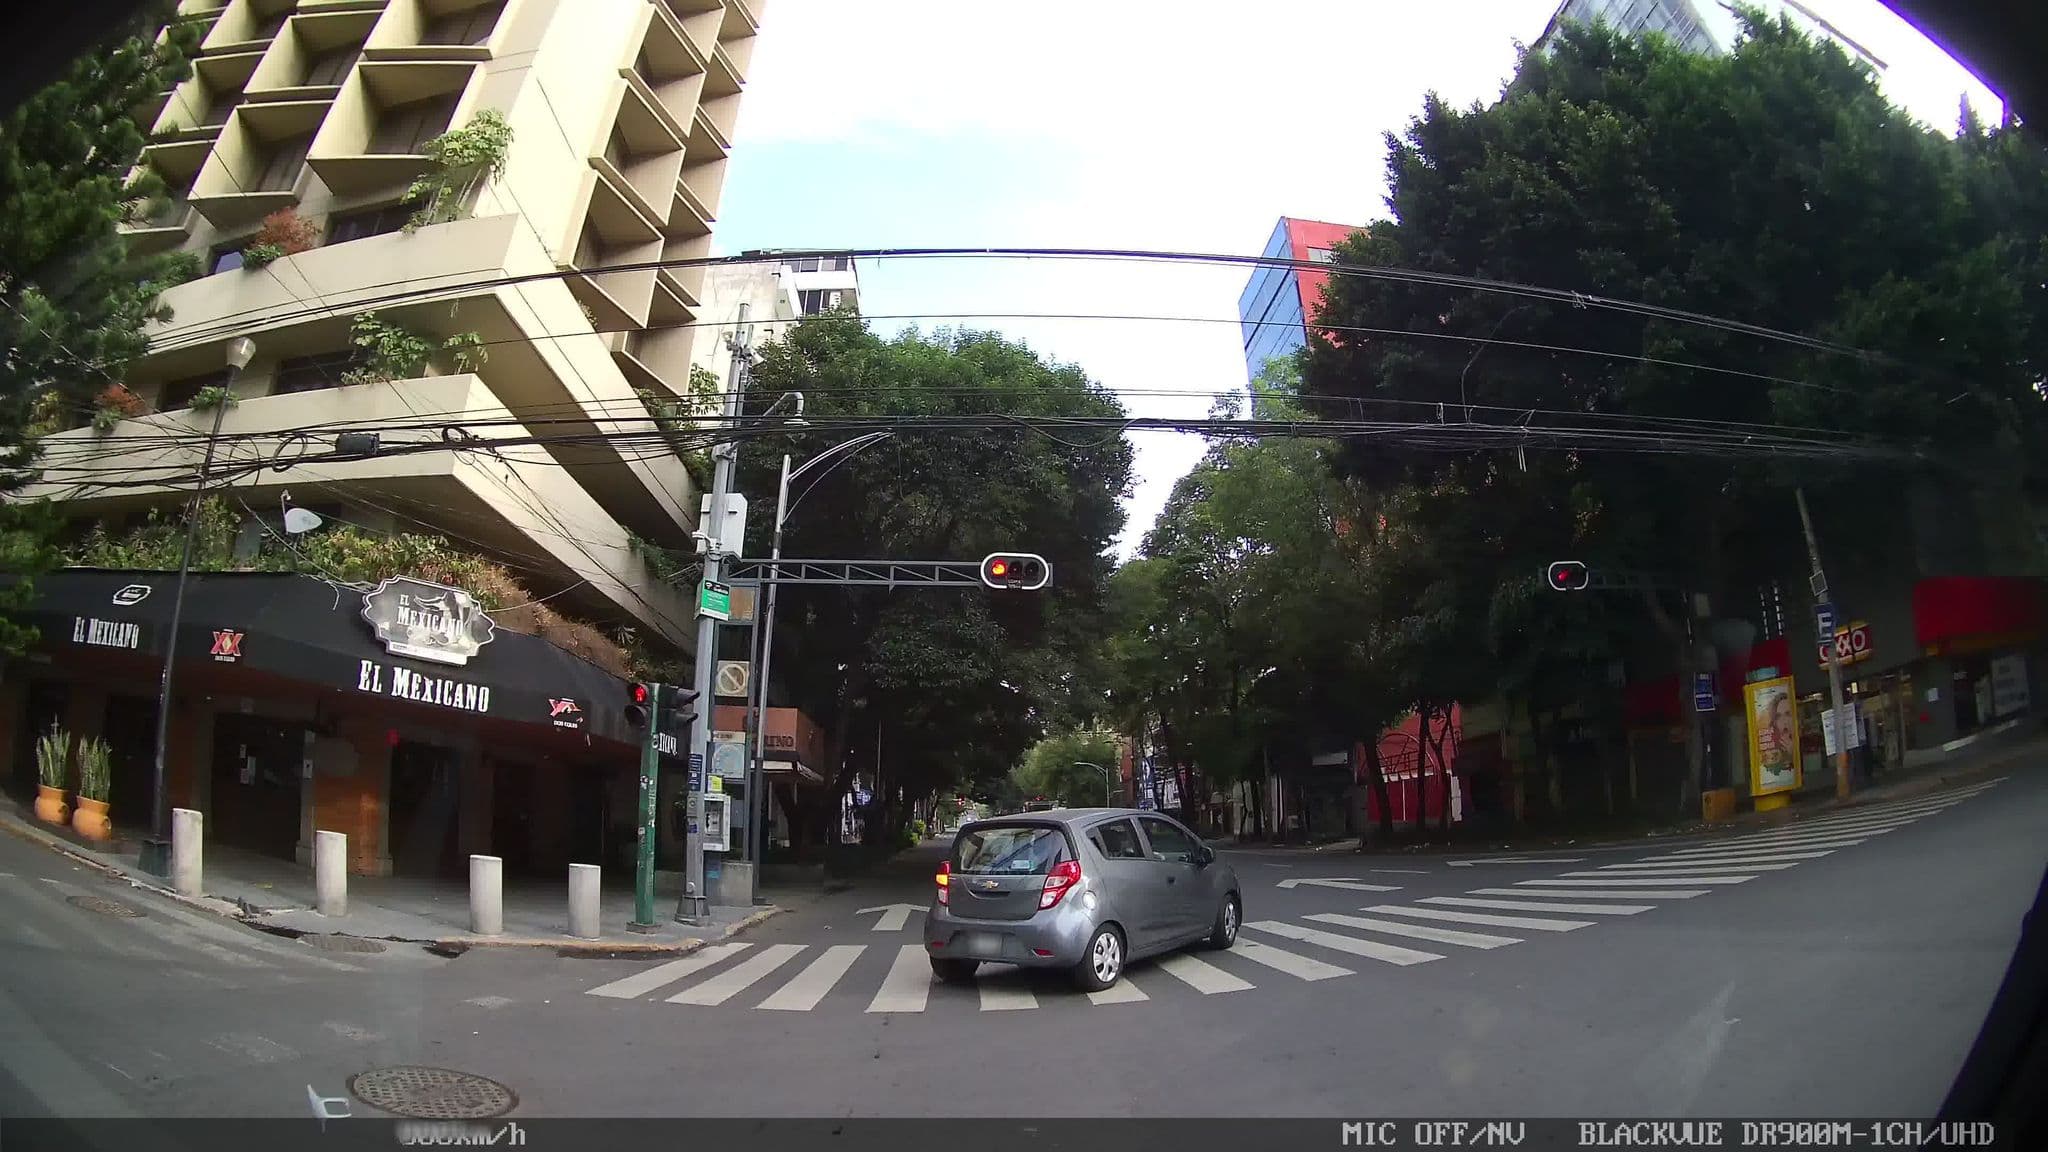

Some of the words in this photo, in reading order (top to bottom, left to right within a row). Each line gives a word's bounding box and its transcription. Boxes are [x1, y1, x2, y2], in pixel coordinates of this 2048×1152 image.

[399, 594, 409, 606] EL
[72, 616, 85, 643] EL
[87, 618, 140, 649] MEXICANO
[397, 606, 464, 638] MEXICANO
[358, 659, 383, 694] EL
[391, 666, 490, 713] MEXICANO
